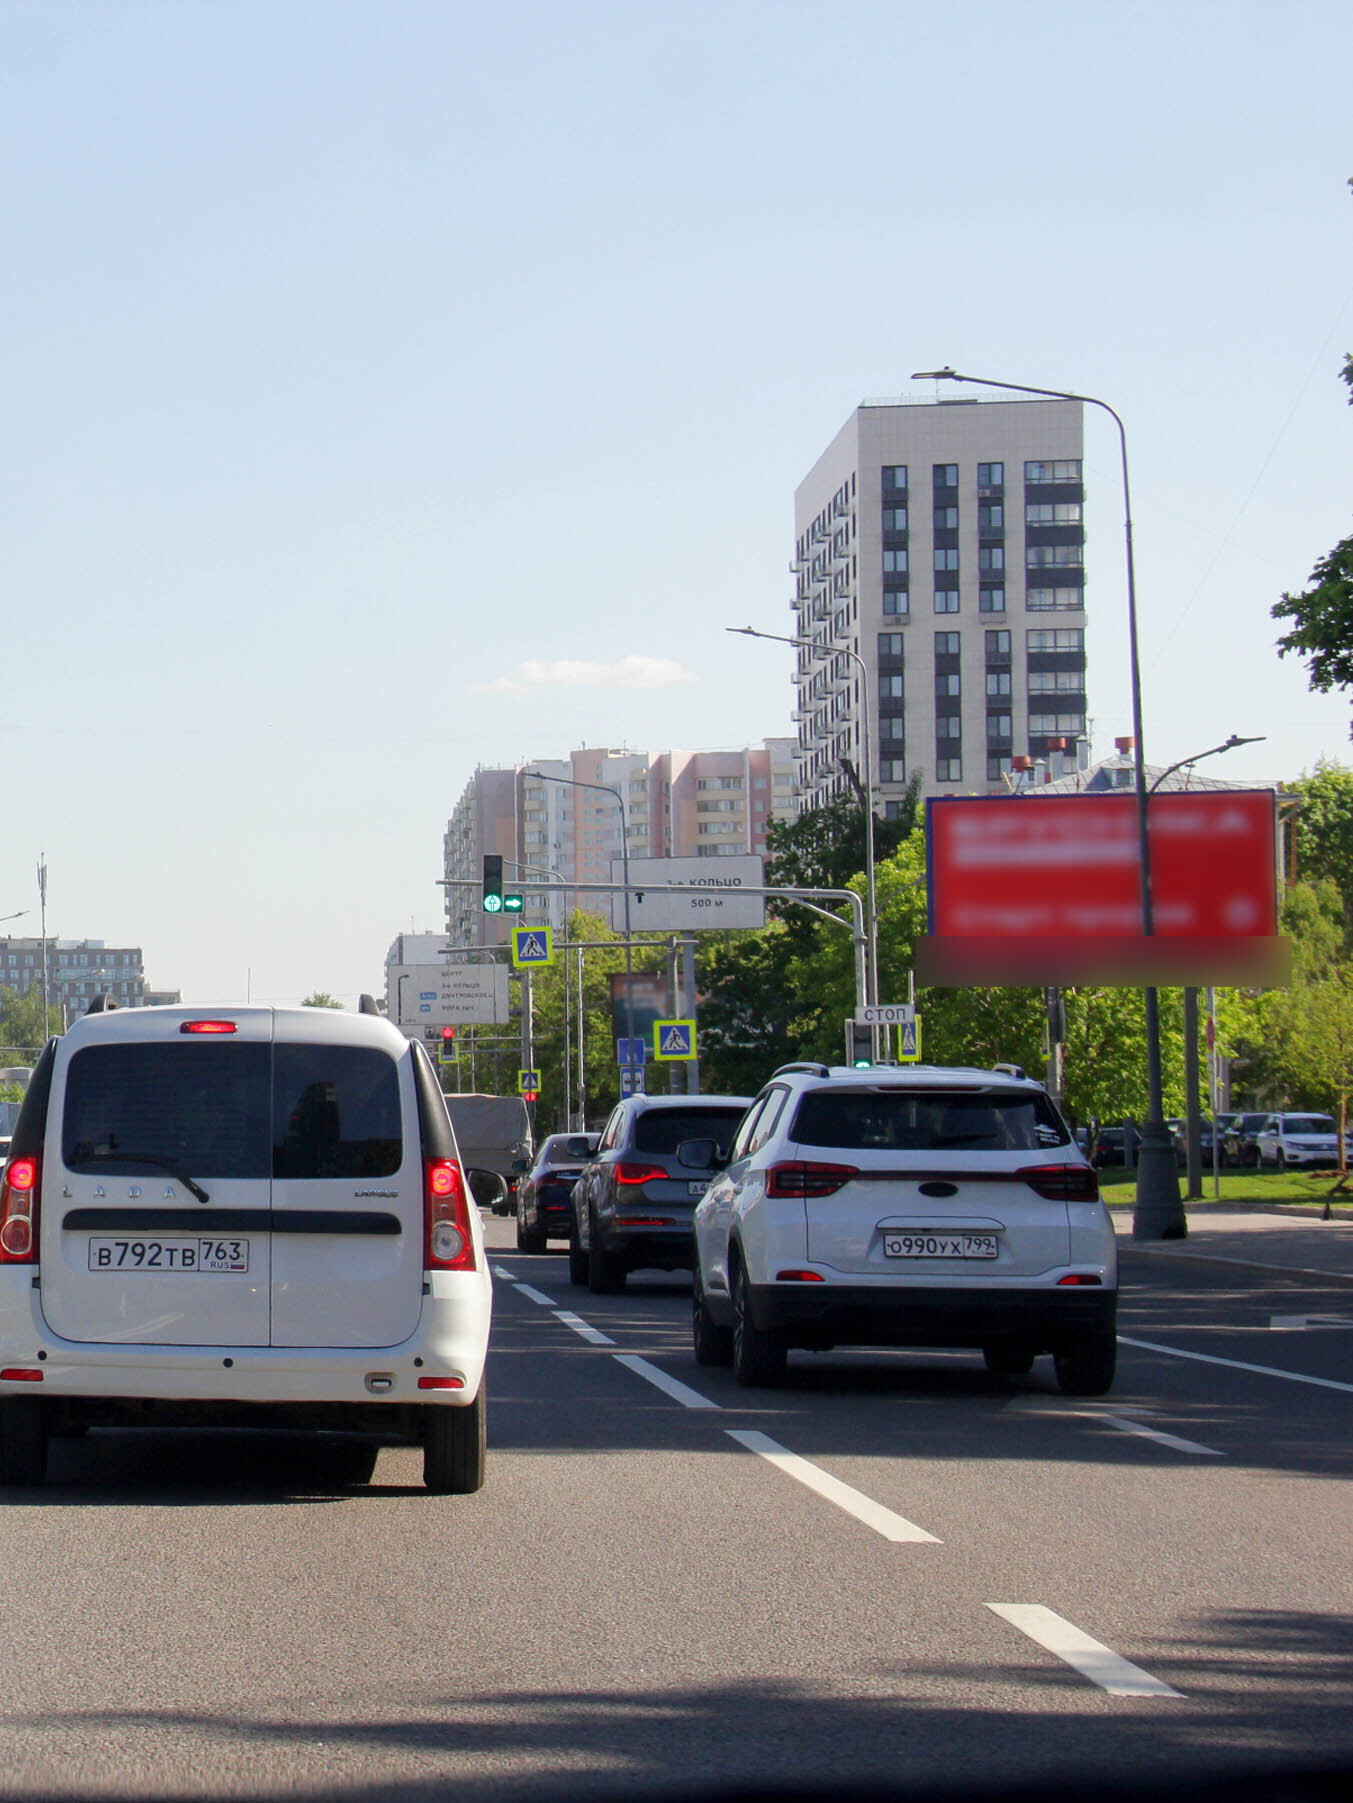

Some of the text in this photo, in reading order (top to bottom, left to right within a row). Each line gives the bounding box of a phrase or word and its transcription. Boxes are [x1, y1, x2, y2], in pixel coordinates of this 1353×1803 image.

[689, 877, 742, 887] КОЛЬЦО
[691, 899, 711, 908] 500
[864, 1008, 906, 1021] СТОП
[63, 1184, 177, 1200] LADA
[890, 1237, 991, 1254] О990УХ 799
[98, 1241, 241, 1267] В792ТВ 763
[210, 1261, 230, 1269] RUS
